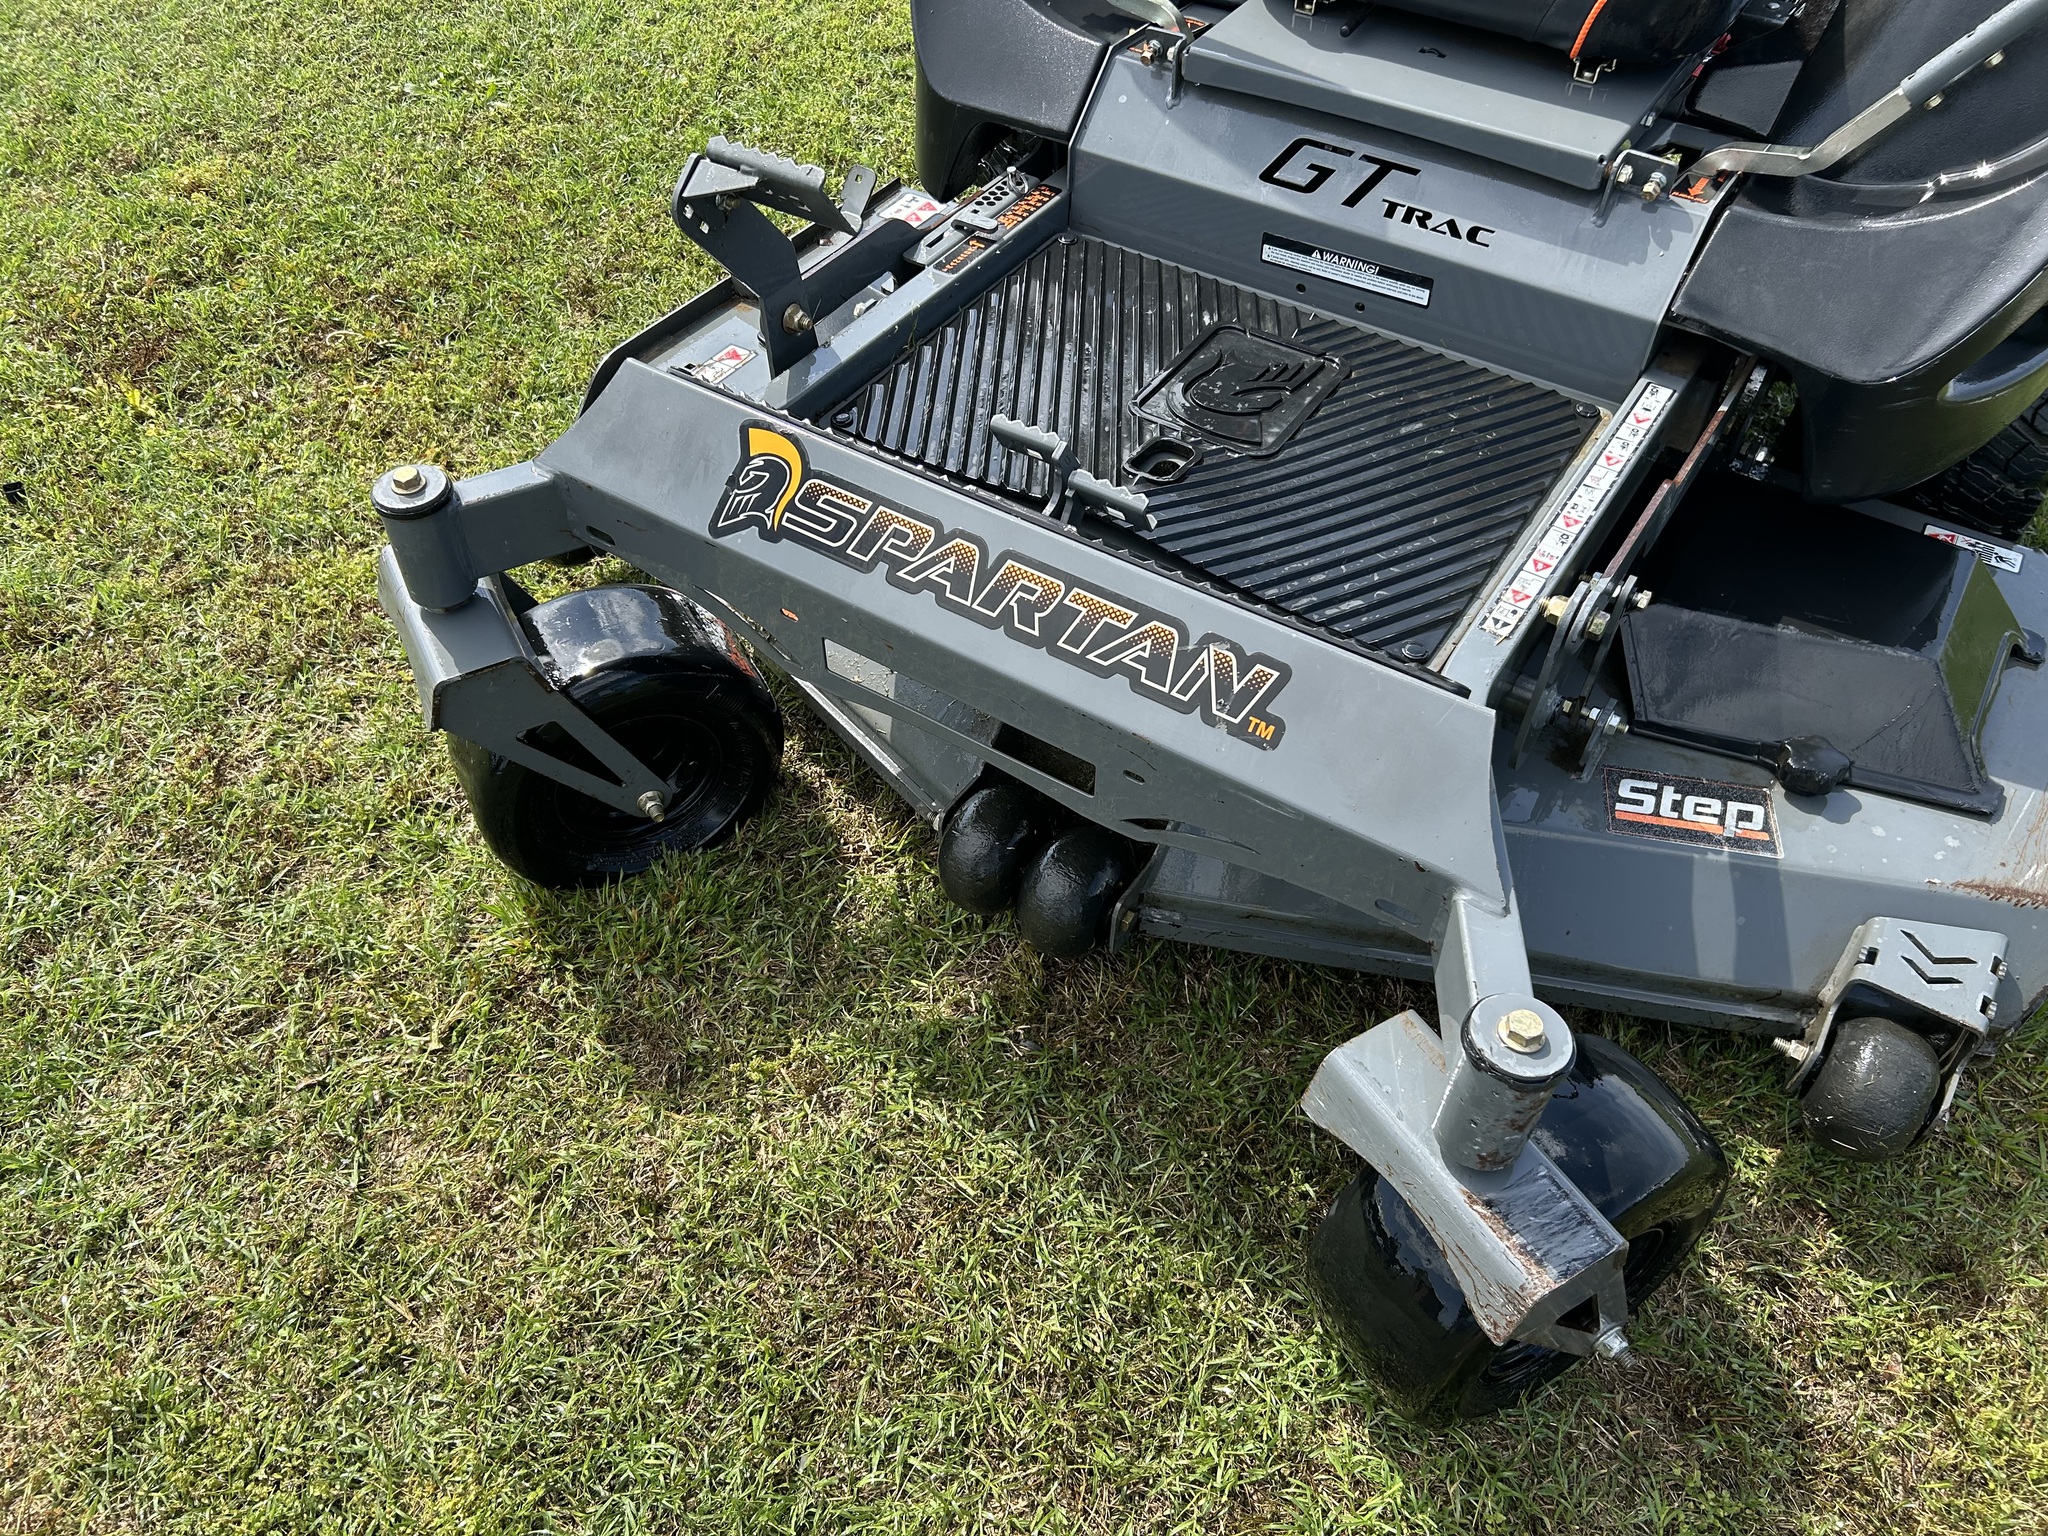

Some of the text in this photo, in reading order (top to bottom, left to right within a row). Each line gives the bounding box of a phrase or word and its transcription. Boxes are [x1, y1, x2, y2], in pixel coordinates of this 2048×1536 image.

[1258, 137, 1422, 209] GT
[1381, 198, 1496, 248] TRAC
[1322, 251, 1380, 275] WARNING!
[780, 477, 1280, 741] SPARTAN TM
[1614, 778, 1765, 838] Step
